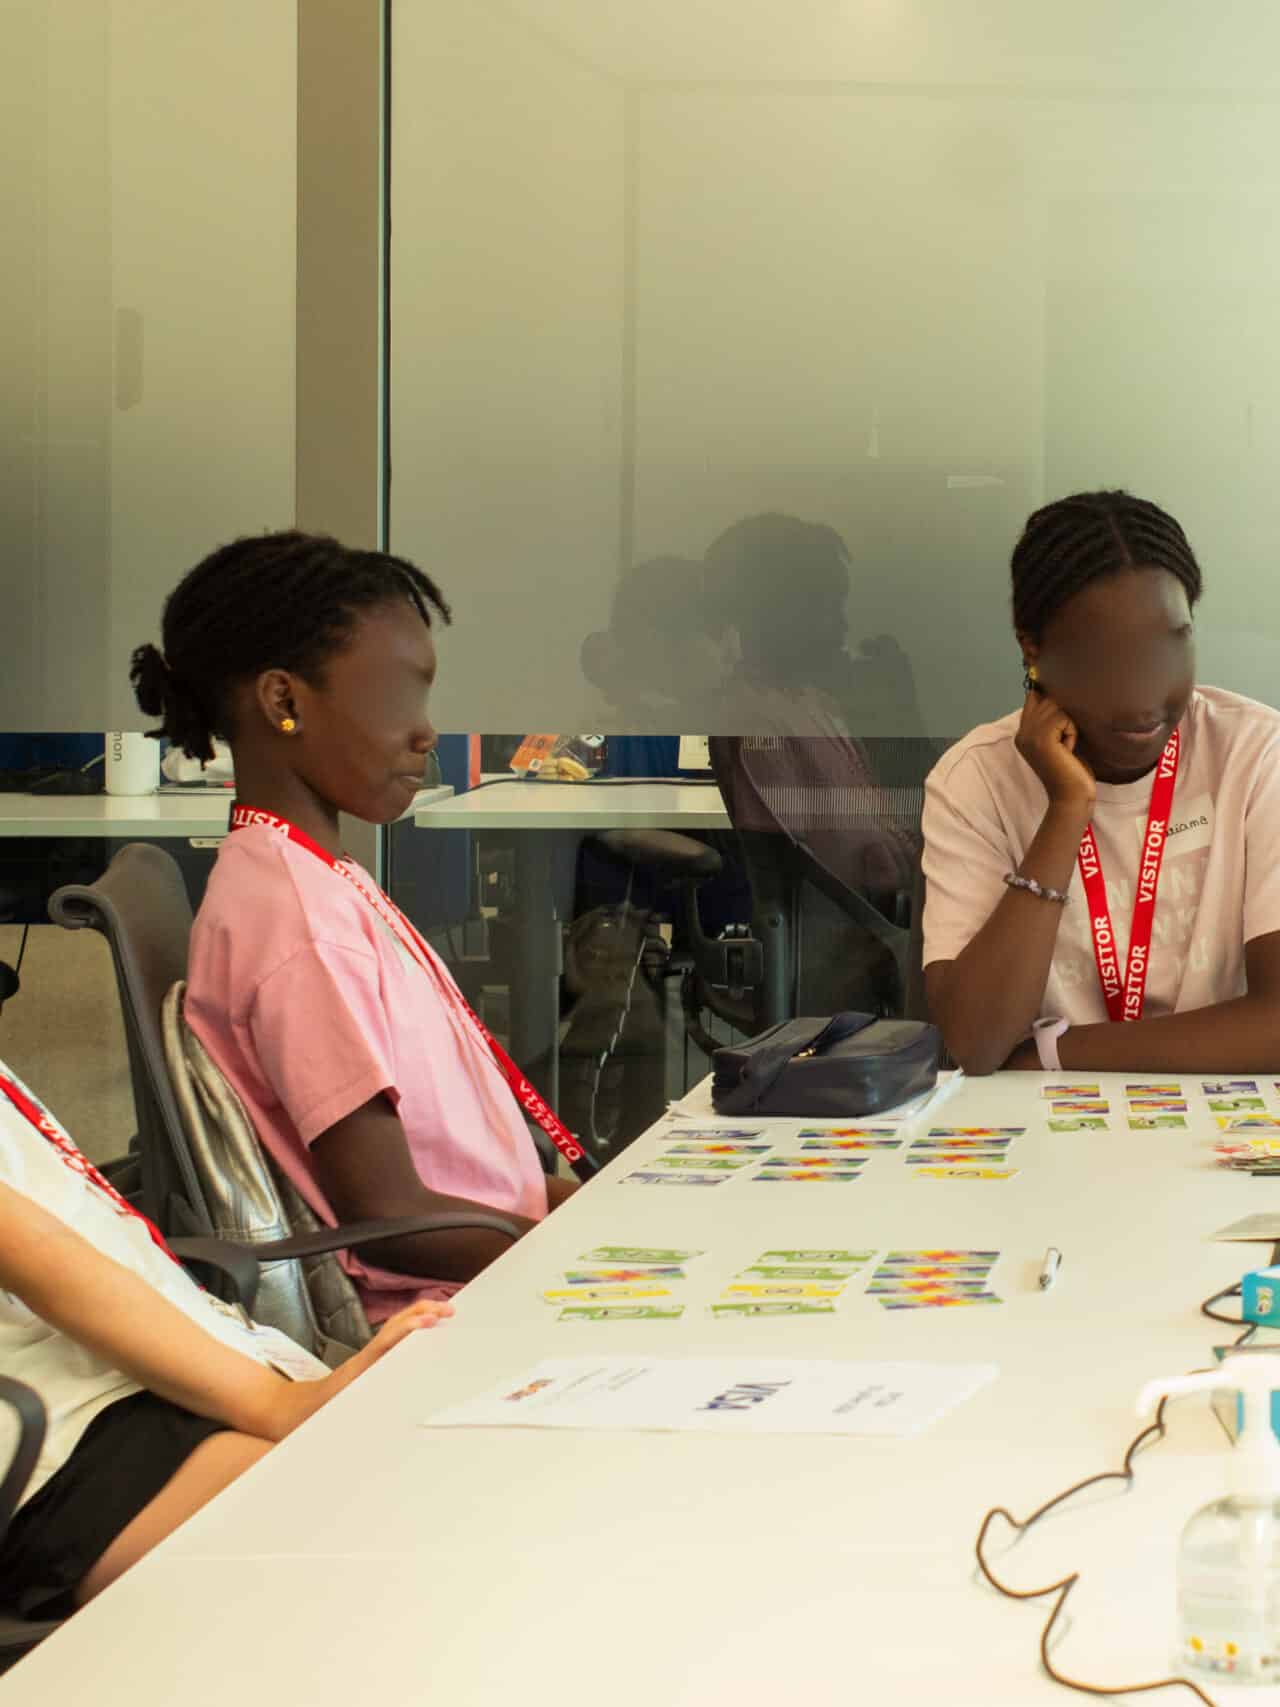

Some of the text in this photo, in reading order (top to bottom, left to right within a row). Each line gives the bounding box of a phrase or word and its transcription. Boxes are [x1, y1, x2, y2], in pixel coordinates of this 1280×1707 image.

[1159, 730, 1178, 779] VISI
[1079, 826, 1099, 879] VISI
[1138, 819, 1166, 904] VISITOR
[1094, 915, 1121, 999] VISITOR
